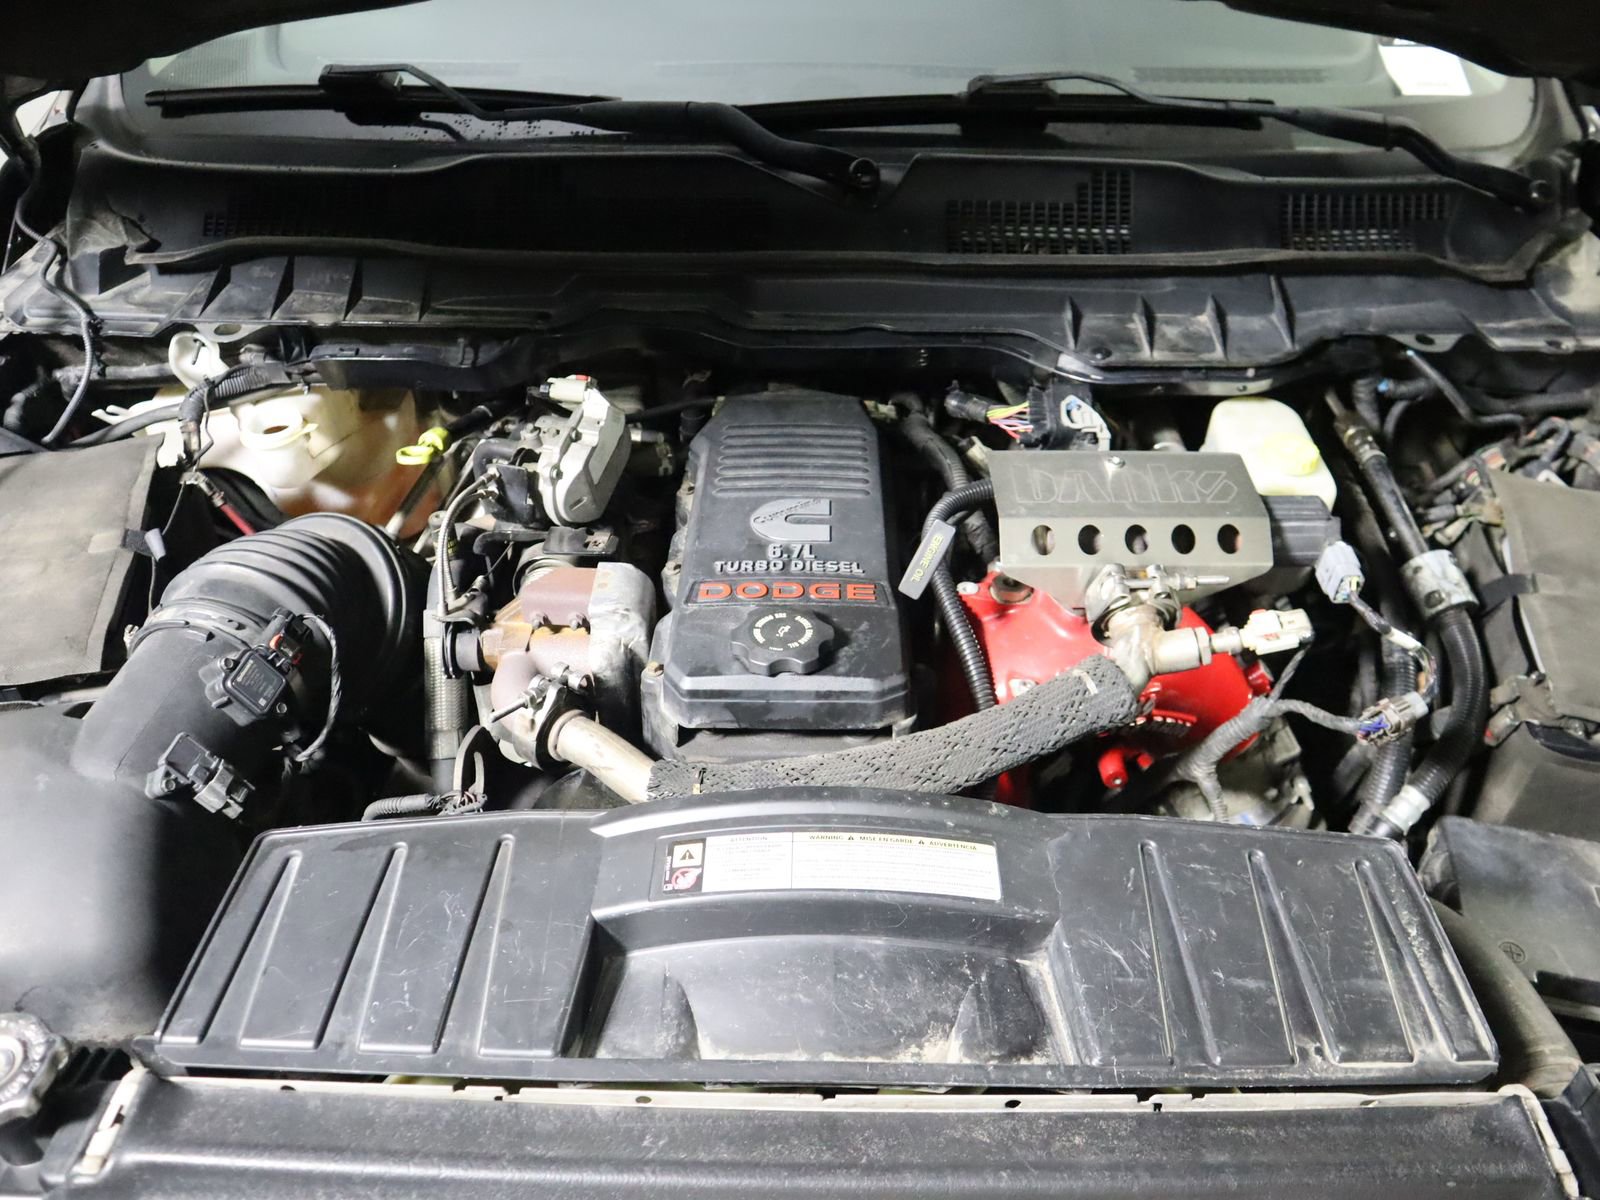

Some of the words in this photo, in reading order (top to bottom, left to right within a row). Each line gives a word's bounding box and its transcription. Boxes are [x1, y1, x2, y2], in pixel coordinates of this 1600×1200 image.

[768, 543, 817, 560] 6.7L
[919, 534, 945, 569] ENGINE
[714, 559, 786, 574] TURBO
[790, 560, 865, 575] DIESEL
[911, 568, 925, 582] OIL
[697, 581, 878, 601] DODGE
[859, 834, 877, 842] MISE
[929, 840, 977, 851] ADVERTENCIA
